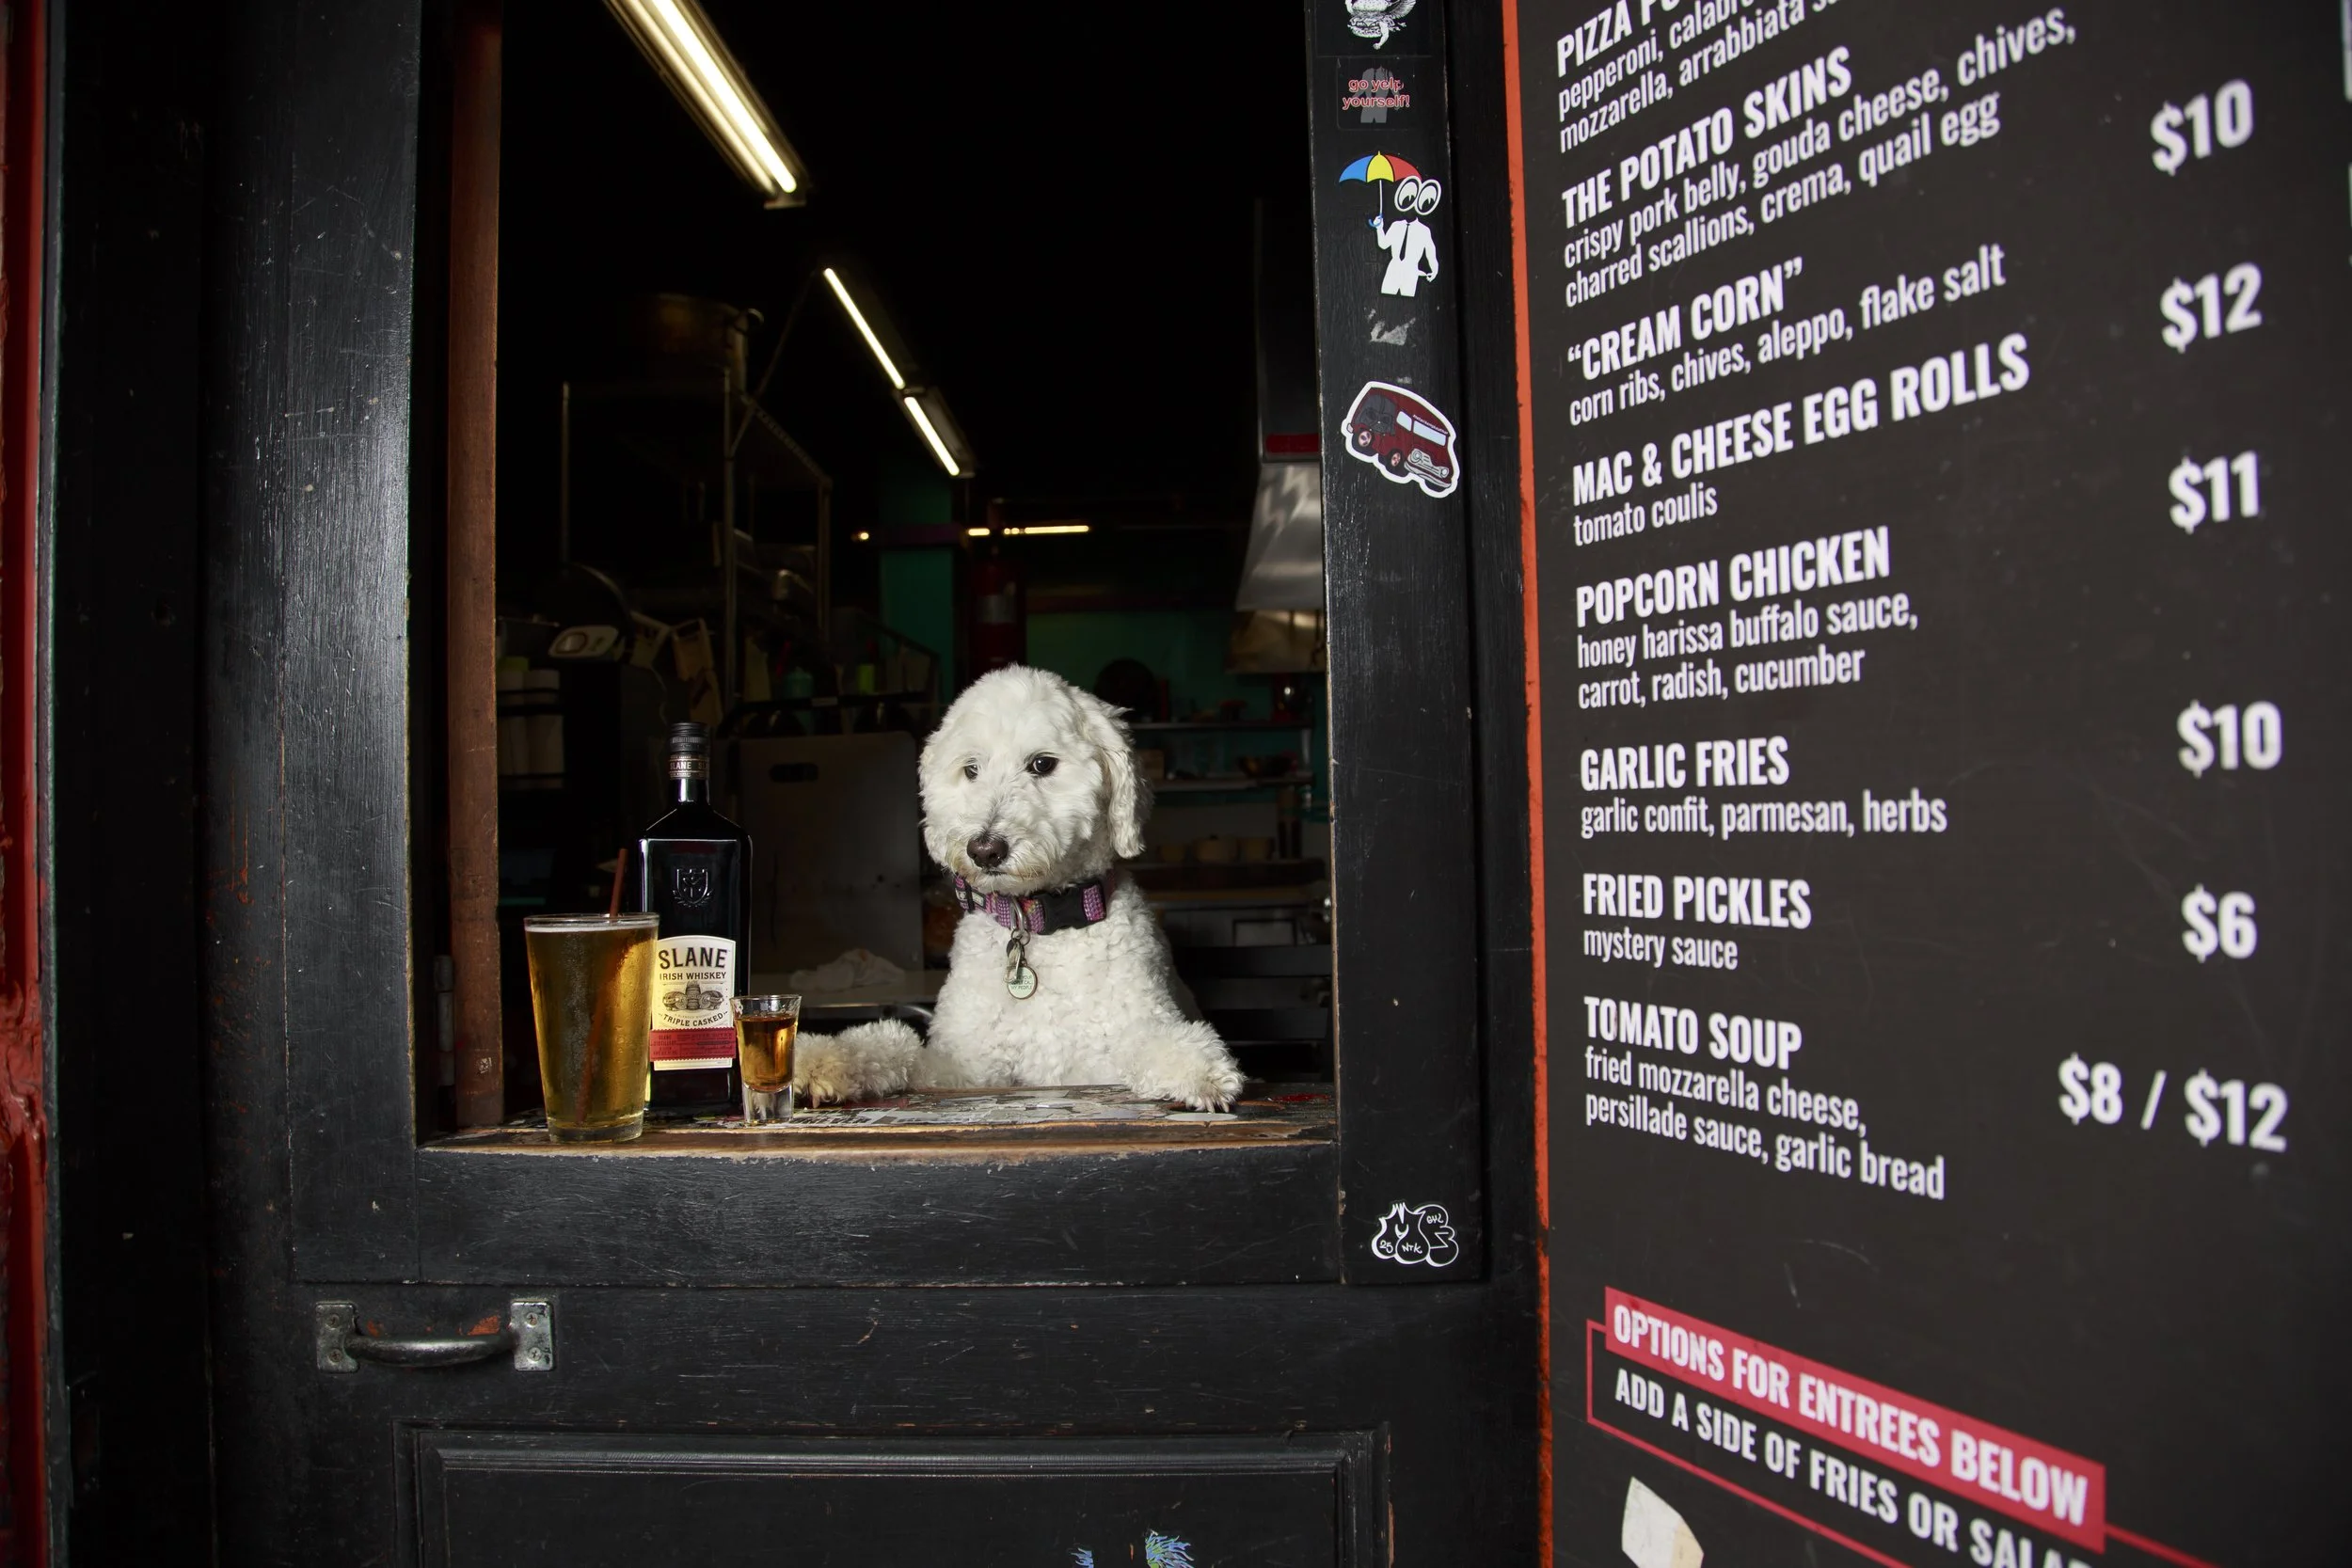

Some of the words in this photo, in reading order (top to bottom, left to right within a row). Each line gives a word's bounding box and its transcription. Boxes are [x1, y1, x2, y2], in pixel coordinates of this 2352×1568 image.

[1556, 0, 1632, 78] PIZZA
[1558, 36, 1663, 122] pepperoni,
[1669, 0, 1754, 50] calabr
[1560, 70, 1674, 153] mozzarella,
[1678, 0, 1805, 87] arrabbiata
[1343, 95, 1410, 110] yourself!
[1348, 78, 1368, 92] go
[1372, 77, 1404, 92] yelp
[1561, 168, 1613, 230] THE
[1619, 107, 1734, 202] POTATO
[1743, 46, 1851, 139] SKINS
[1564, 218, 1624, 269] crispy
[1629, 187, 1679, 246] pork
[1683, 160, 1746, 214] belly,
[1753, 118, 1831, 189] gouda
[1838, 69, 1948, 142] cheese,
[1957, 8, 2075, 87] chives,
[2151, 82, 2252, 175] $10
[1565, 243, 1643, 308] charred
[1648, 205, 1755, 272] scallions,
[1760, 164, 1851, 224] crema,
[1858, 112, 1931, 187] quail
[1940, 92, 2000, 147] egg
[1567, 305, 1681, 381] “CREAM
[1691, 256, 1803, 341] CORN”
[1569, 388, 1613, 426] corn
[1619, 369, 1666, 410] ribs,
[1671, 342, 1751, 392] chives,
[1757, 308, 1853, 364] aleppo,
[1859, 275, 1935, 330] flake
[1943, 244, 2006, 302] salt
[2160, 264, 2262, 353] $12
[1572, 451, 1633, 507] MAC
[1641, 442, 1662, 487] &
[1671, 402, 1794, 479] CHEESE
[1803, 378, 1879, 445] EGG
[1890, 333, 2029, 422] ROLLS
[1573, 501, 1645, 546] tomato
[1651, 481, 1718, 529] coulis
[2169, 451, 2259, 533] $11
[1576, 560, 1720, 628] POPCORN
[1729, 525, 1890, 602] CHICKEN
[1577, 634, 1637, 669] honey
[1642, 619, 1724, 660] harissa
[1729, 598, 1819, 648] buffalo
[1826, 593, 1918, 635] sauce,
[1578, 670, 1646, 709] carrot,
[1651, 657, 1728, 702] radish,
[1734, 643, 1866, 694] cucumber
[1580, 742, 1687, 792] GARLIC
[1695, 736, 1789, 787] FRIES
[2177, 701, 2281, 777] $10
[1581, 796, 1639, 840] garlic
[1644, 795, 1715, 837] confit,
[1721, 800, 1855, 841] parmesan,
[1863, 787, 1947, 832] herbs
[1582, 873, 1663, 919] FRIED
[1673, 876, 1812, 929] PICKLES
[2182, 885, 2257, 962] $6
[659, 946, 727, 970] SLANE
[686, 972, 726, 980] WHISKEY
[1583, 926, 1666, 969] mystery
[1671, 936, 1739, 971] sauce
[663, 1013, 690, 1026] TRIPLE
[692, 1012, 723, 1026] CASKED
[1583, 995, 1699, 1054] TOMATO
[1708, 1012, 1803, 1070] SOUP
[1584, 1045, 1632, 1086] fried
[1638, 1062, 1759, 1112] mozzarella
[1766, 1077, 1867, 1138] cheese,
[2058, 1053, 2122, 1125] $8
[2141, 1070, 2166, 1130] /
[2185, 1070, 2287, 1151] $12
[1585, 1093, 1687, 1141] persillade
[1692, 1116, 1769, 1164] sauce,
[1774, 1132, 1851, 1179] garlic
[1860, 1140, 1945, 1200] bread
[1613, 1304, 1725, 1382] OPTIONS
[1732, 1347, 1790, 1409] FOR
[1798, 1372, 1941, 1467] ENTREES
[1950, 1429, 2088, 1526] BELOW
[1614, 1368, 1664, 1418] ADD
[1671, 1392, 1690, 1432] A
[1696, 1402, 1757, 1462] SIDE
[1764, 1432, 1802, 1479] OF
[1809, 1449, 1899, 1524] FRIES
[1908, 1492, 1958, 1552] OR
[1970, 1518, 2090, 1568] SAL
